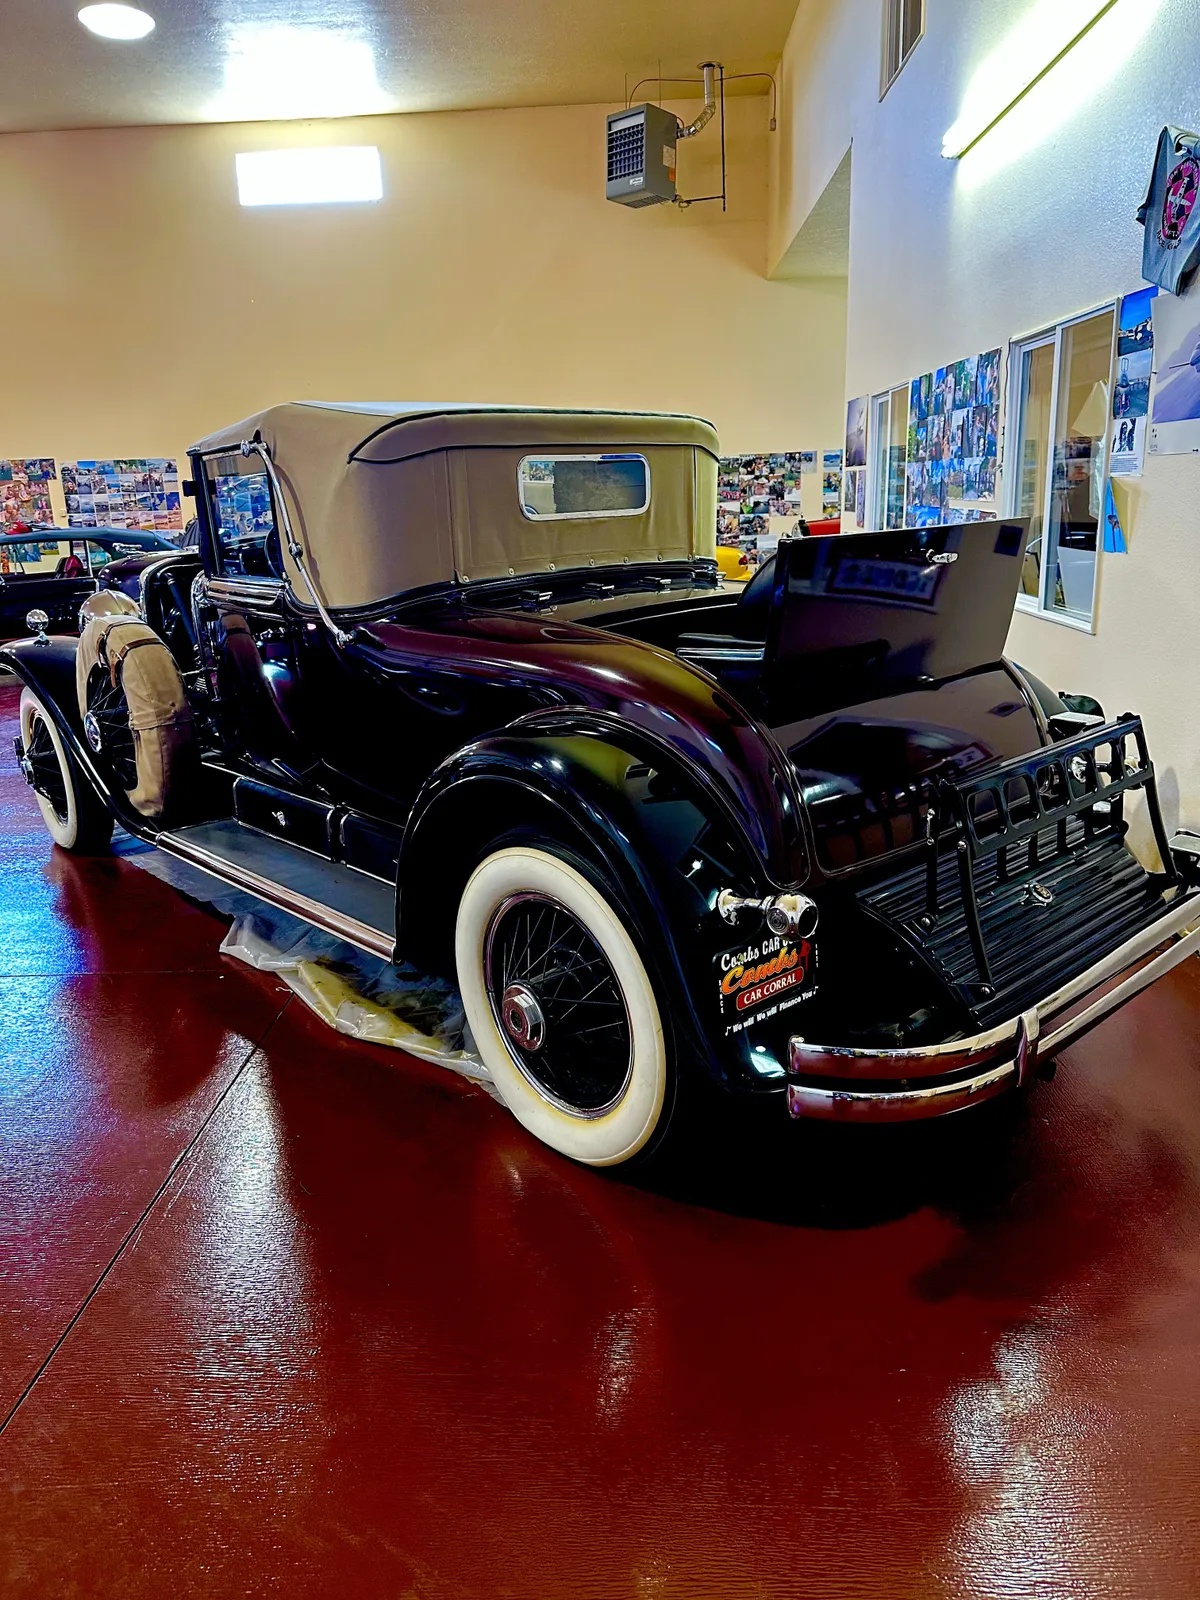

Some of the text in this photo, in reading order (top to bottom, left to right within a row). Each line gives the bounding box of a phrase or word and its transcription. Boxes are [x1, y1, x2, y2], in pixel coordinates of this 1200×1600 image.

[762, 936, 780, 955] CAR
[722, 947, 798, 995] Combs
[743, 973, 797, 1005] CAR CORRAL
[733, 1024, 743, 1033] We
[757, 1013, 766, 1021] We
[780, 997, 802, 1011] Finance
[802, 991, 813, 1000] You
